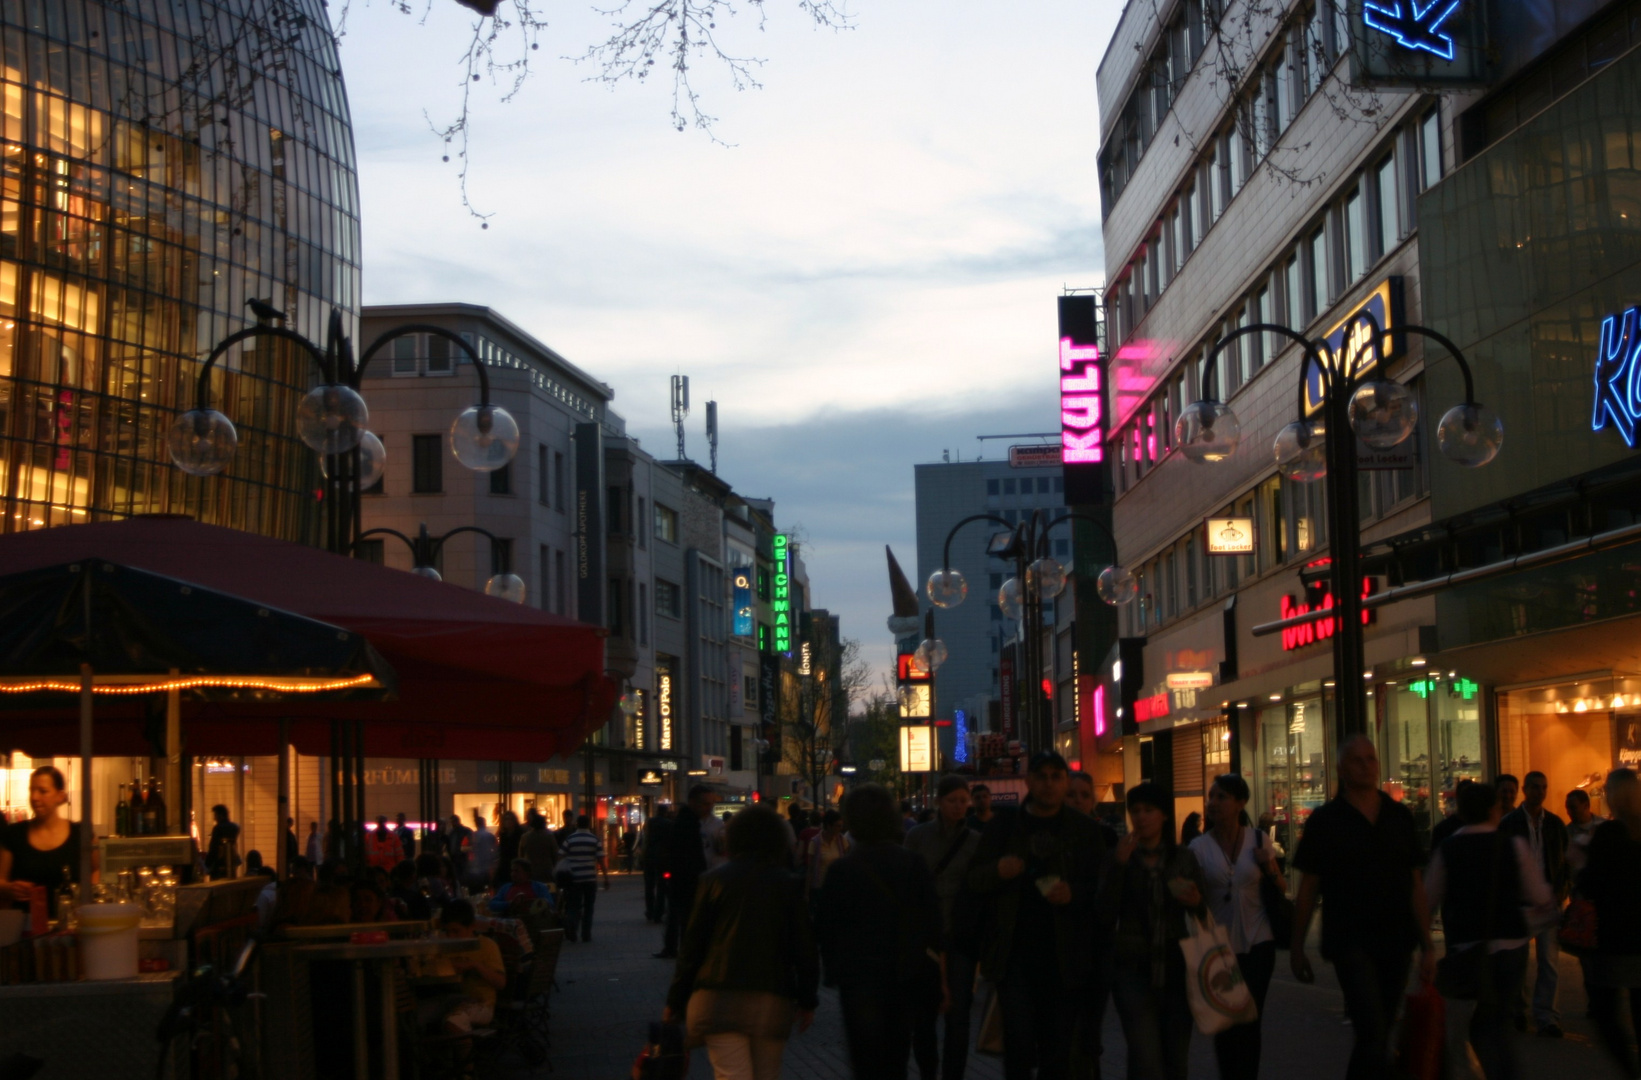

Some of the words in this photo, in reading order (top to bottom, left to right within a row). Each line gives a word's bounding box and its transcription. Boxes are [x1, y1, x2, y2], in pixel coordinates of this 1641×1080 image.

[1592, 306, 1641, 449] K
[1060, 337, 1102, 463] KULT
[1356, 454, 1374, 463] oot
[579, 490, 588, 533] APOTHEKE
[774, 534, 789, 652] DEICHMANN
[763, 663, 774, 690] Hut
[1002, 674, 1010, 695] KING
[660, 676, 671, 716] O'Polo
[763, 691, 776, 724] Pizza
[1002, 696, 1010, 728] BURGER
[661, 718, 671, 750] Marc
